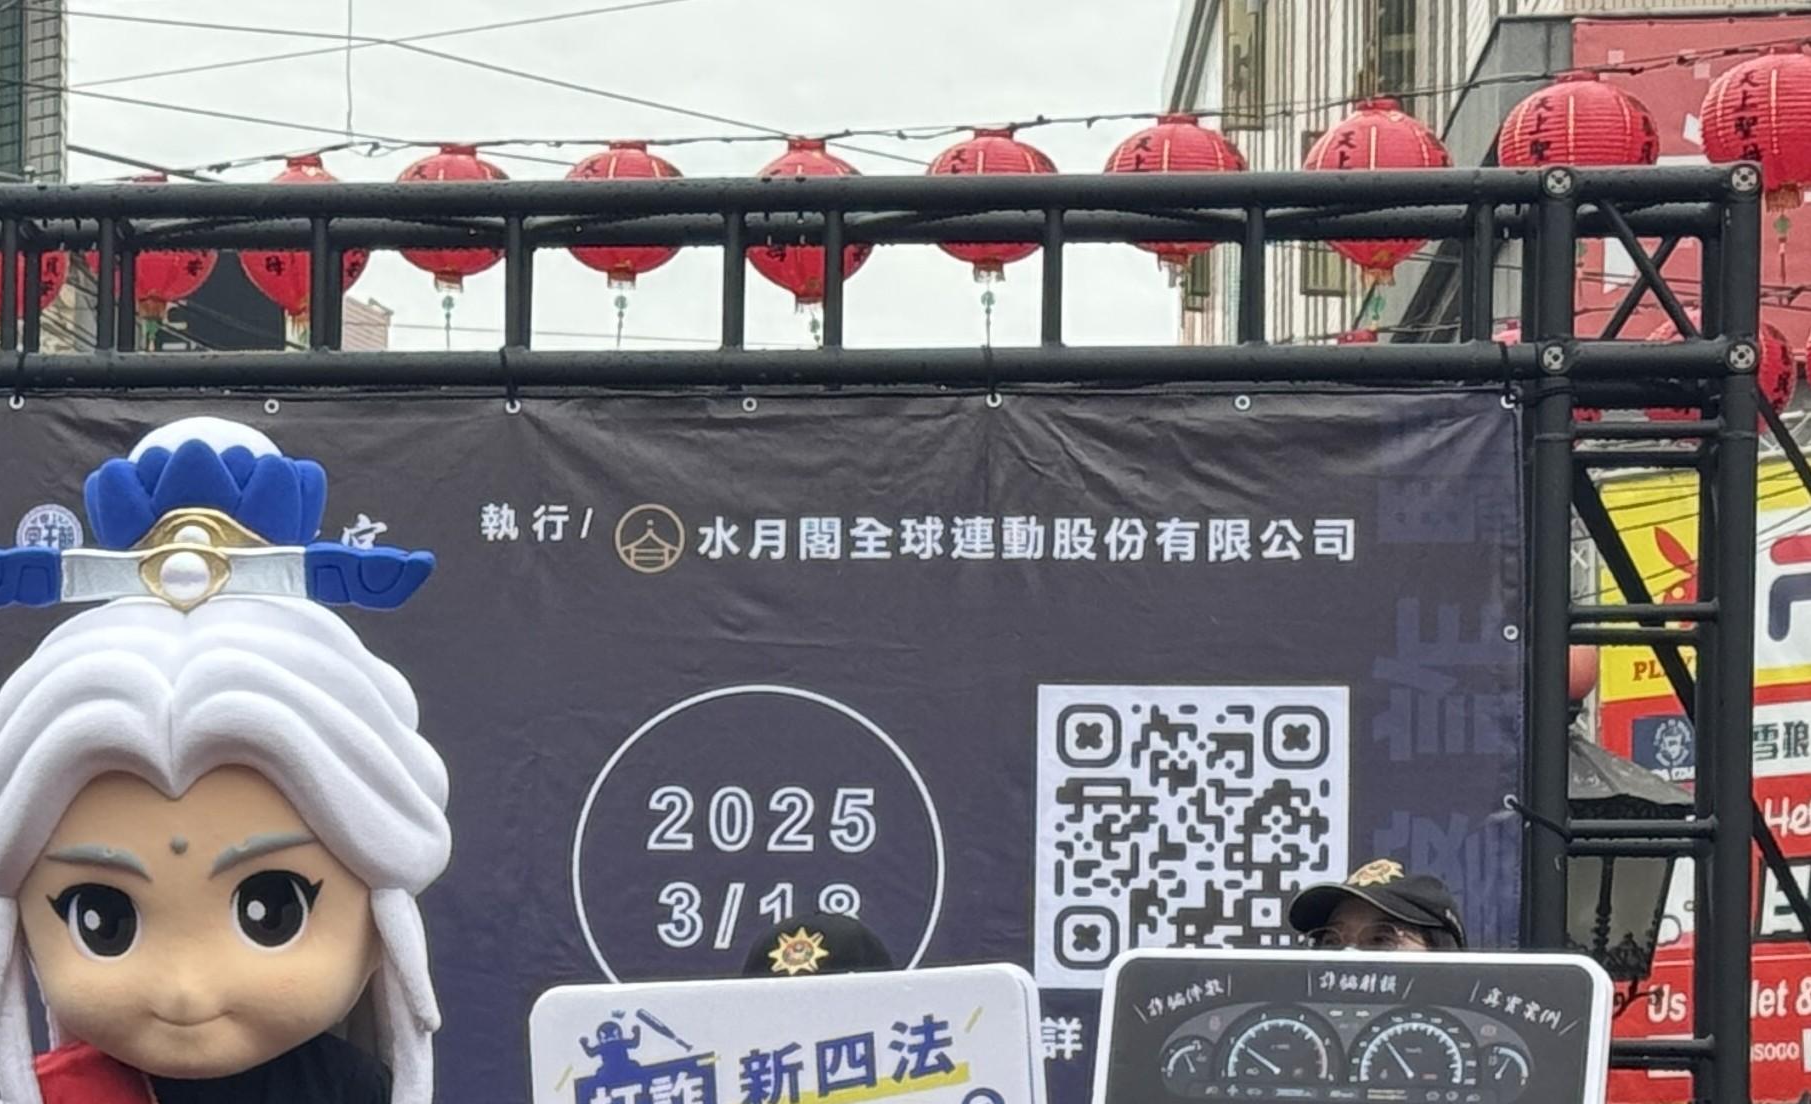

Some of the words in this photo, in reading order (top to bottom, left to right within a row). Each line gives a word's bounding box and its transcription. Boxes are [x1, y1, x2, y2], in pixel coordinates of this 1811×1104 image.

[696, 515, 1357, 562] 水月閣全球連動股份有限公司
[646, 785, 877, 853] 2025
